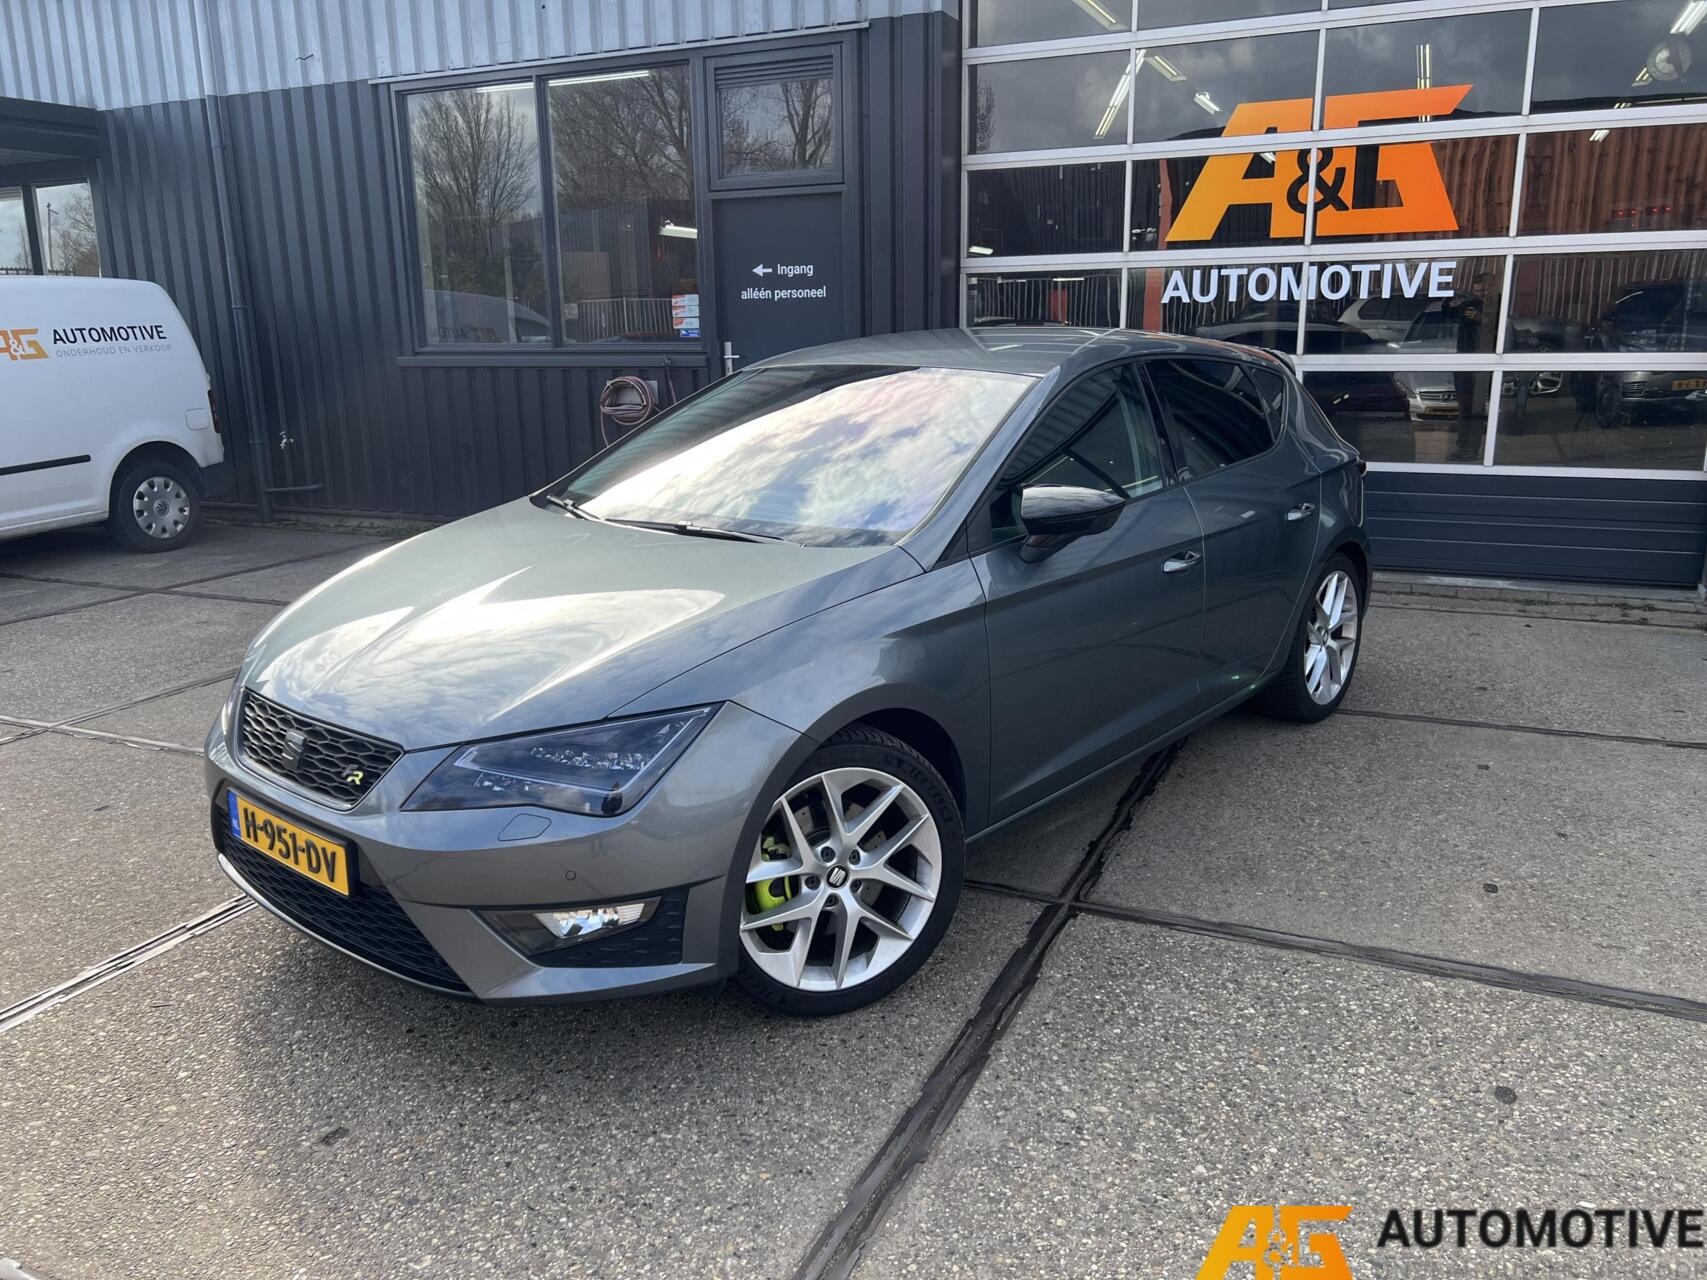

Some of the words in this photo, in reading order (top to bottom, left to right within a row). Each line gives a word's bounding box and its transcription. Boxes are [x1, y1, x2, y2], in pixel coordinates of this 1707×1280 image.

[1165, 84, 1473, 241] A&G
[777, 264, 813, 277] Ingang
[1161, 261, 1457, 304] AUTOMOTIVE
[741, 287, 772, 299] alléén
[774, 286, 826, 301] personeel
[53, 325, 167, 344] AUTOMOTIVE
[56, 346, 116, 358] ONDERHOUD
[119, 345, 131, 353] EN
[134, 343, 172, 353] VERKOOP
[341, 764, 364, 785] FR
[243, 807, 336, 883] H-951-DV
